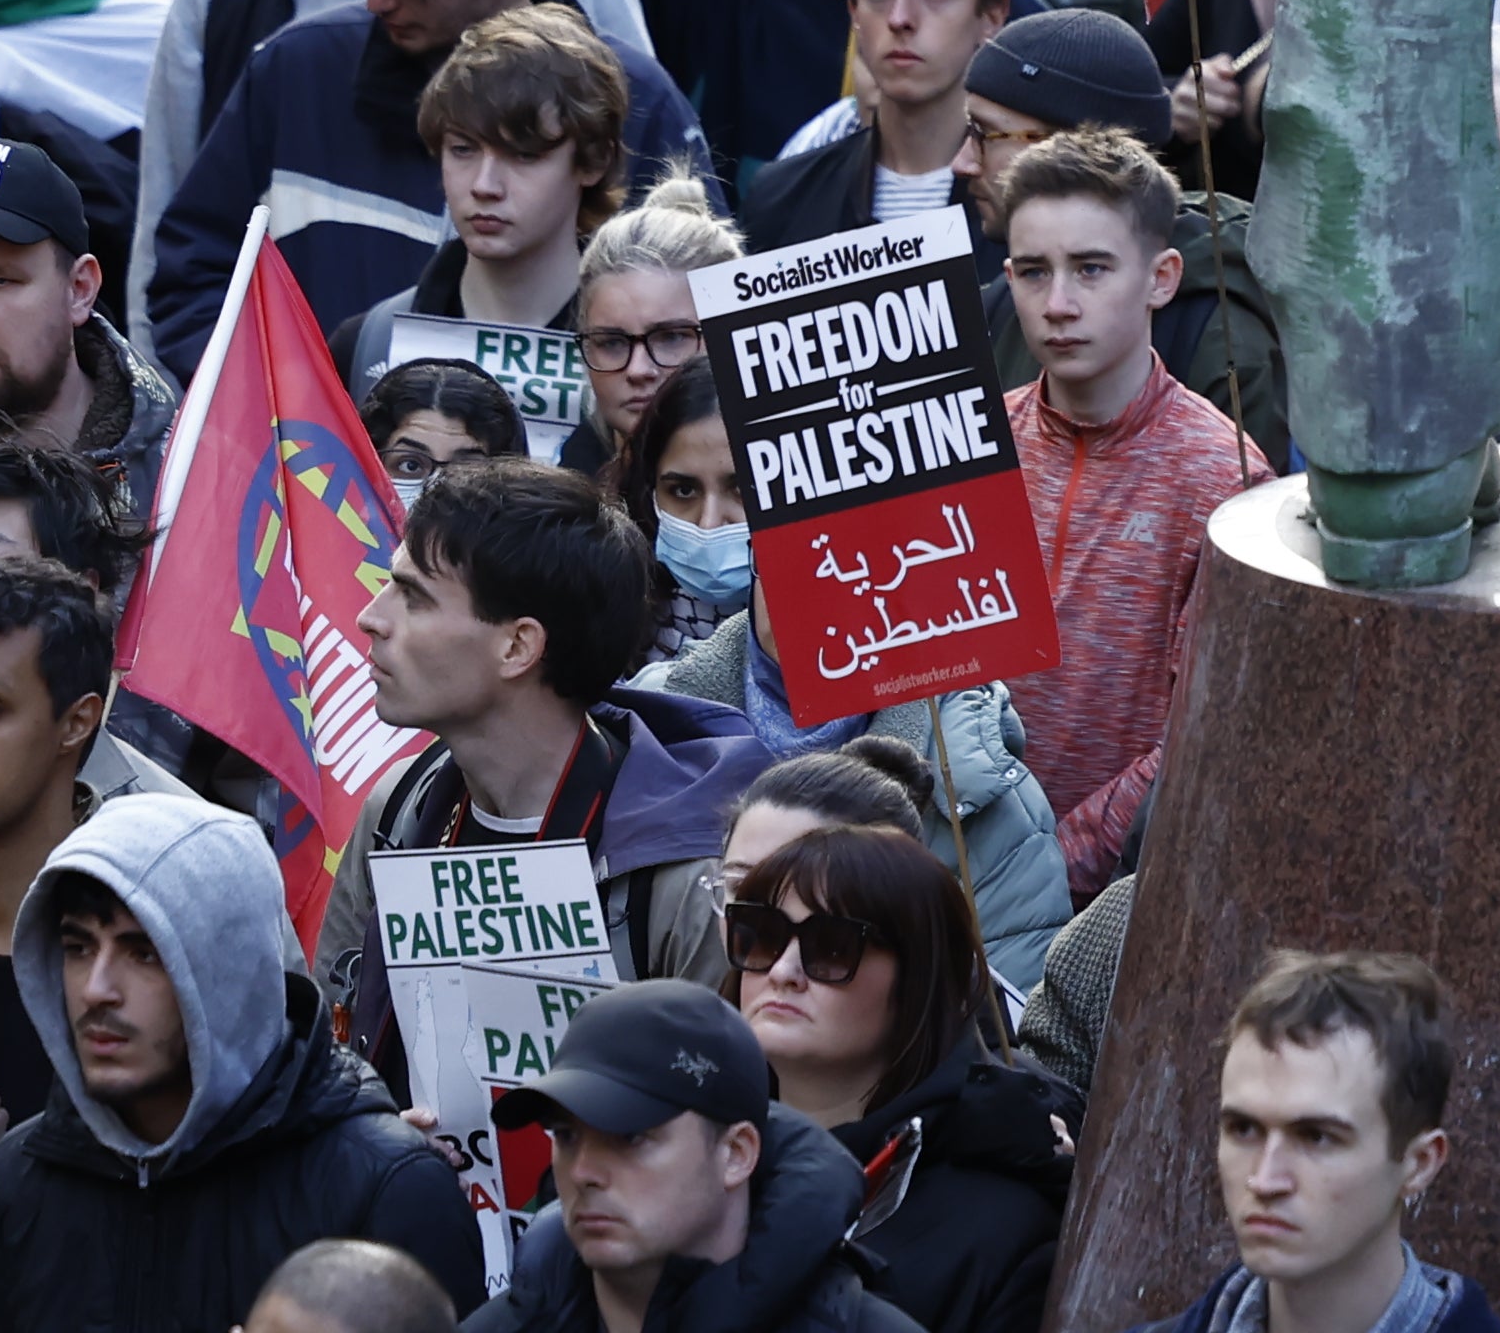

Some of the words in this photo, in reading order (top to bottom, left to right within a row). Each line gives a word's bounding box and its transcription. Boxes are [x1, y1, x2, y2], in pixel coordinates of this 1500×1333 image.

[733, 252, 837, 302] Socialist
[833, 234, 925, 279] Worker
[474, 329, 585, 375] FREE
[731, 279, 959, 400] FREEDOM
[838, 378, 876, 414] for
[746, 386, 999, 511] PALESTINE
[811, 502, 976, 597] الحرية
[818, 568, 1021, 681] لفلسطين
[430, 856, 524, 907] FREE
[385, 900, 600, 961] PALESTINE
